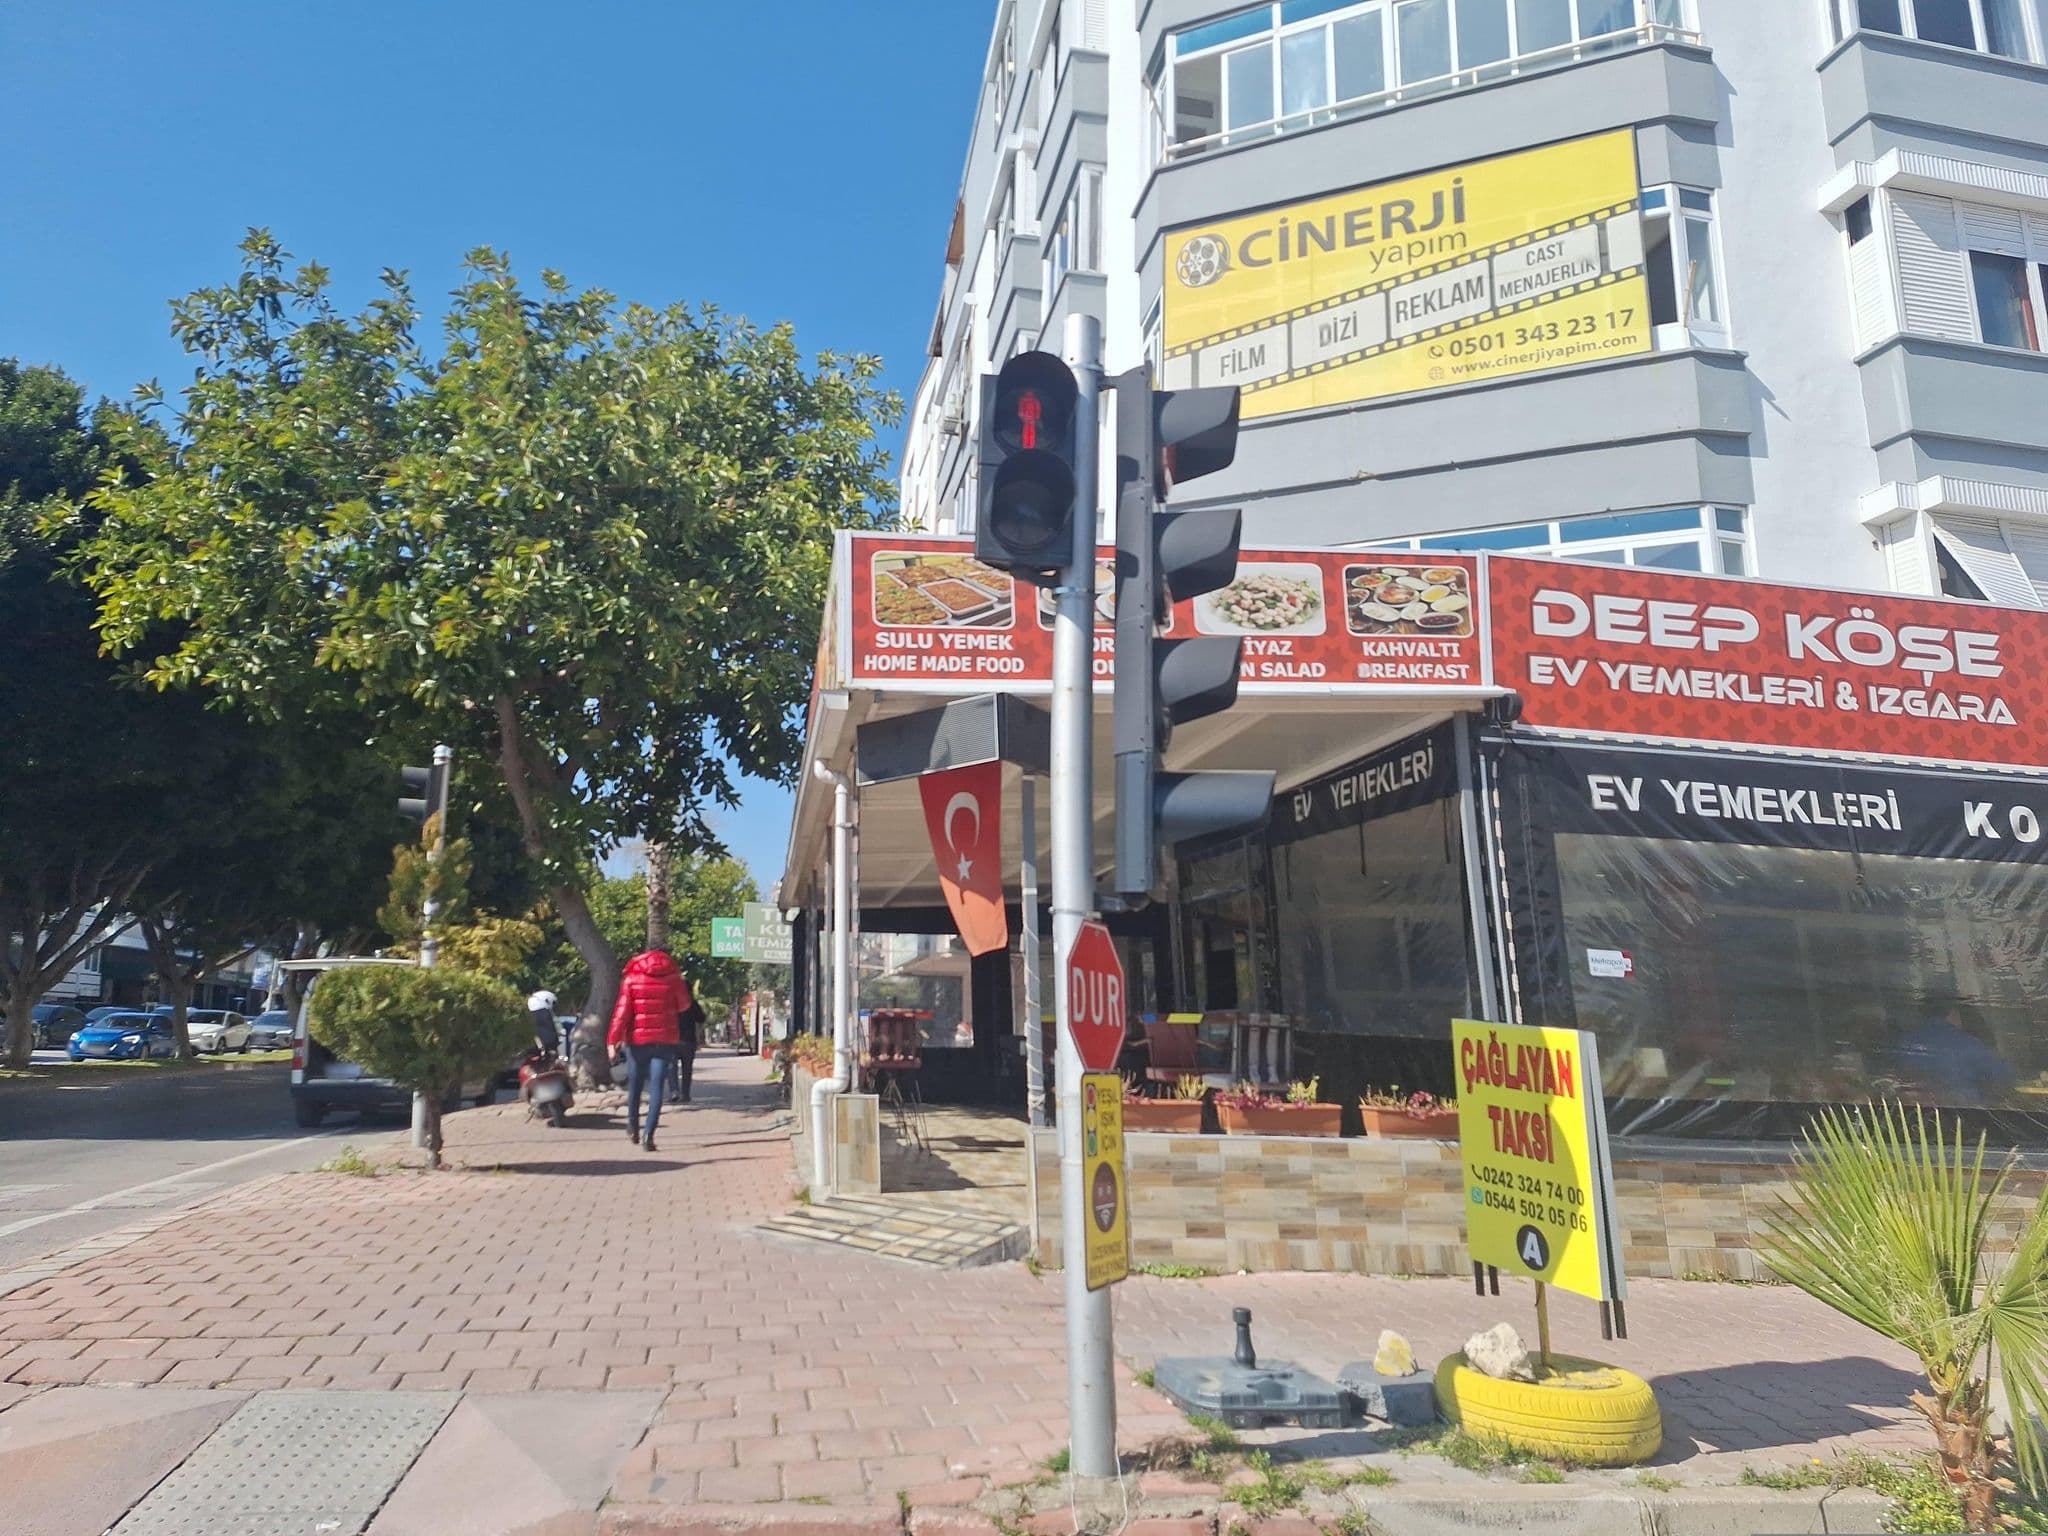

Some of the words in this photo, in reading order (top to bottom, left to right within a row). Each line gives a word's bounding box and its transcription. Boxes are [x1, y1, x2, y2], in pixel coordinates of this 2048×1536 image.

[1238, 176, 1466, 269] CİNERJİ
[1369, 230, 1468, 275] yapım
[1525, 241, 1566, 267] CAST
[1395, 274, 1485, 324] REKLAM
[1318, 310, 1359, 348] DİZİ
[1449, 331, 1506, 358] 0501
[1514, 321, 1561, 347] 343
[1566, 314, 1598, 337] 23
[1605, 307, 1635, 330] 17
[1219, 343, 1266, 378] FİLM
[1450, 334, 1638, 376] www.cinerjiyapim.com
[875, 631, 933, 649] SULU
[938, 633, 1014, 651] YEMEK
[1242, 636, 1294, 656] İYAZ
[1361, 641, 1461, 658] KAHVALTI
[1531, 587, 1761, 653] DEEP
[1785, 606, 2006, 688] KÖŞE
[863, 654, 917, 672] HOME
[921, 655, 972, 673] MADE
[975, 656, 1025, 674] FOOD
[1260, 661, 1327, 678] SALAD
[1357, 662, 1470, 680] BREAKFAST
[1529, 655, 1589, 688] EV
[1600, 660, 1826, 710] YEMEKLERİ
[1835, 685, 1860, 712] &
[1293, 790, 1312, 823] EV
[1330, 739, 1434, 810] YEMEKLERİ
[1586, 774, 1644, 812] EV
[1660, 778, 1902, 831] YEMEKLERİ
[1071, 966, 1122, 1028] DUR
[1461, 1031, 1574, 1098] ÇAĞLAYAN
[1487, 1103, 1555, 1164] TAKSİ
[1482, 1166, 1514, 1189] 0242
[1517, 1174, 1543, 1196] 324
[1545, 1181, 1564, 1201] 74
[1567, 1187, 1585, 1207] 00
[1484, 1190, 1516, 1214] 0544
[1520, 1198, 1545, 1221] 502
[1548, 1207, 1566, 1227] 05
[1570, 1212, 1588, 1233] 06
[1522, 1231, 1543, 1267] A
